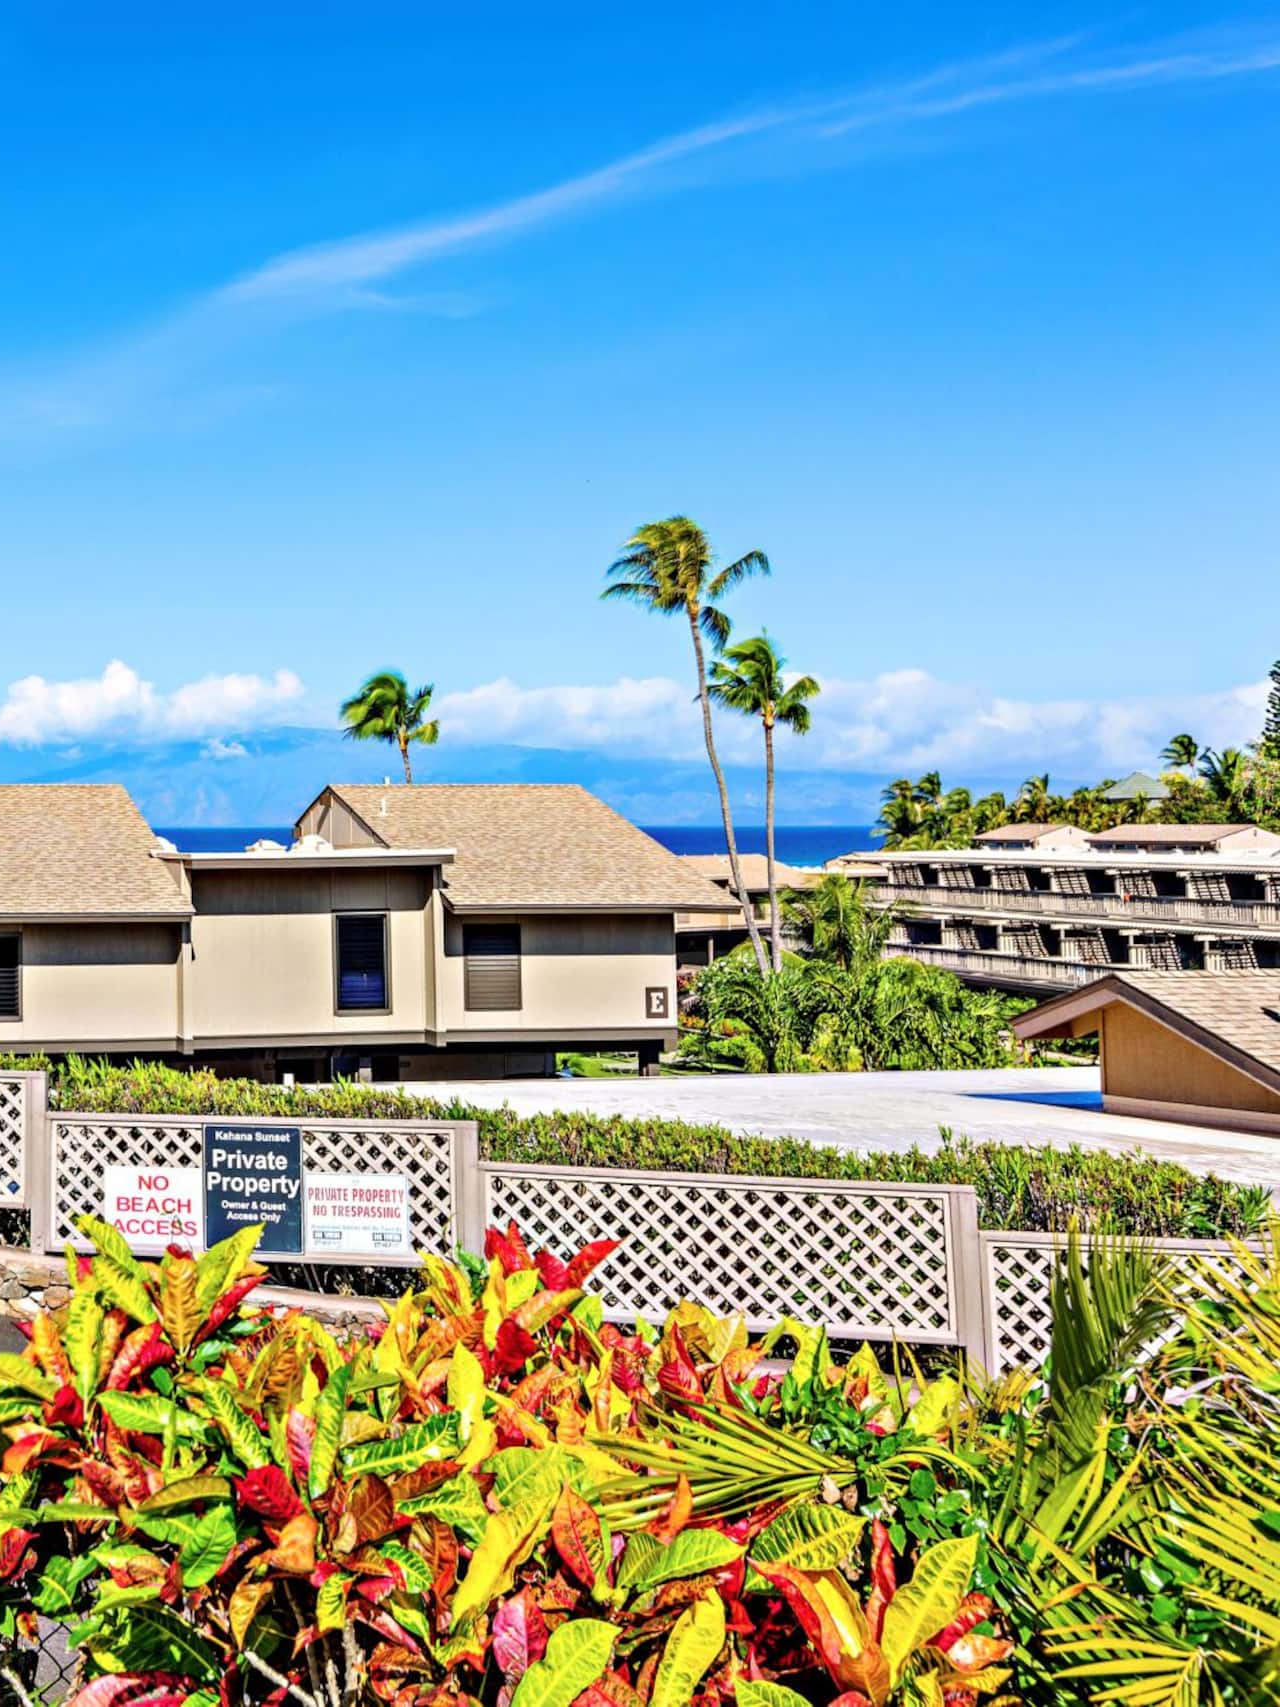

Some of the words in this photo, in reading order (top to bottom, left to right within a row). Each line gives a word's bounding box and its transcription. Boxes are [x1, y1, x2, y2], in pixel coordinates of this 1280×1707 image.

[650, 991, 664, 1013] E
[214, 1130, 253, 1141] Kahana
[255, 1131, 291, 1143] Sunset
[212, 1148, 288, 1170] Private
[138, 1175, 169, 1191] NO
[207, 1171, 300, 1199] Property
[308, 1187, 348, 1201] PRIVATE
[352, 1188, 404, 1204] PROPERTY
[116, 1196, 191, 1214] BEACH
[221, 1200, 250, 1209] Owner
[251, 1201, 258, 1210] &
[260, 1201, 287, 1211] Guest
[313, 1205, 327, 1216] NO
[331, 1205, 401, 1219] TRESPASSING
[226, 1211, 258, 1220] Access
[260, 1212, 281, 1223] Only
[114, 1218, 198, 1236] ACCESS
